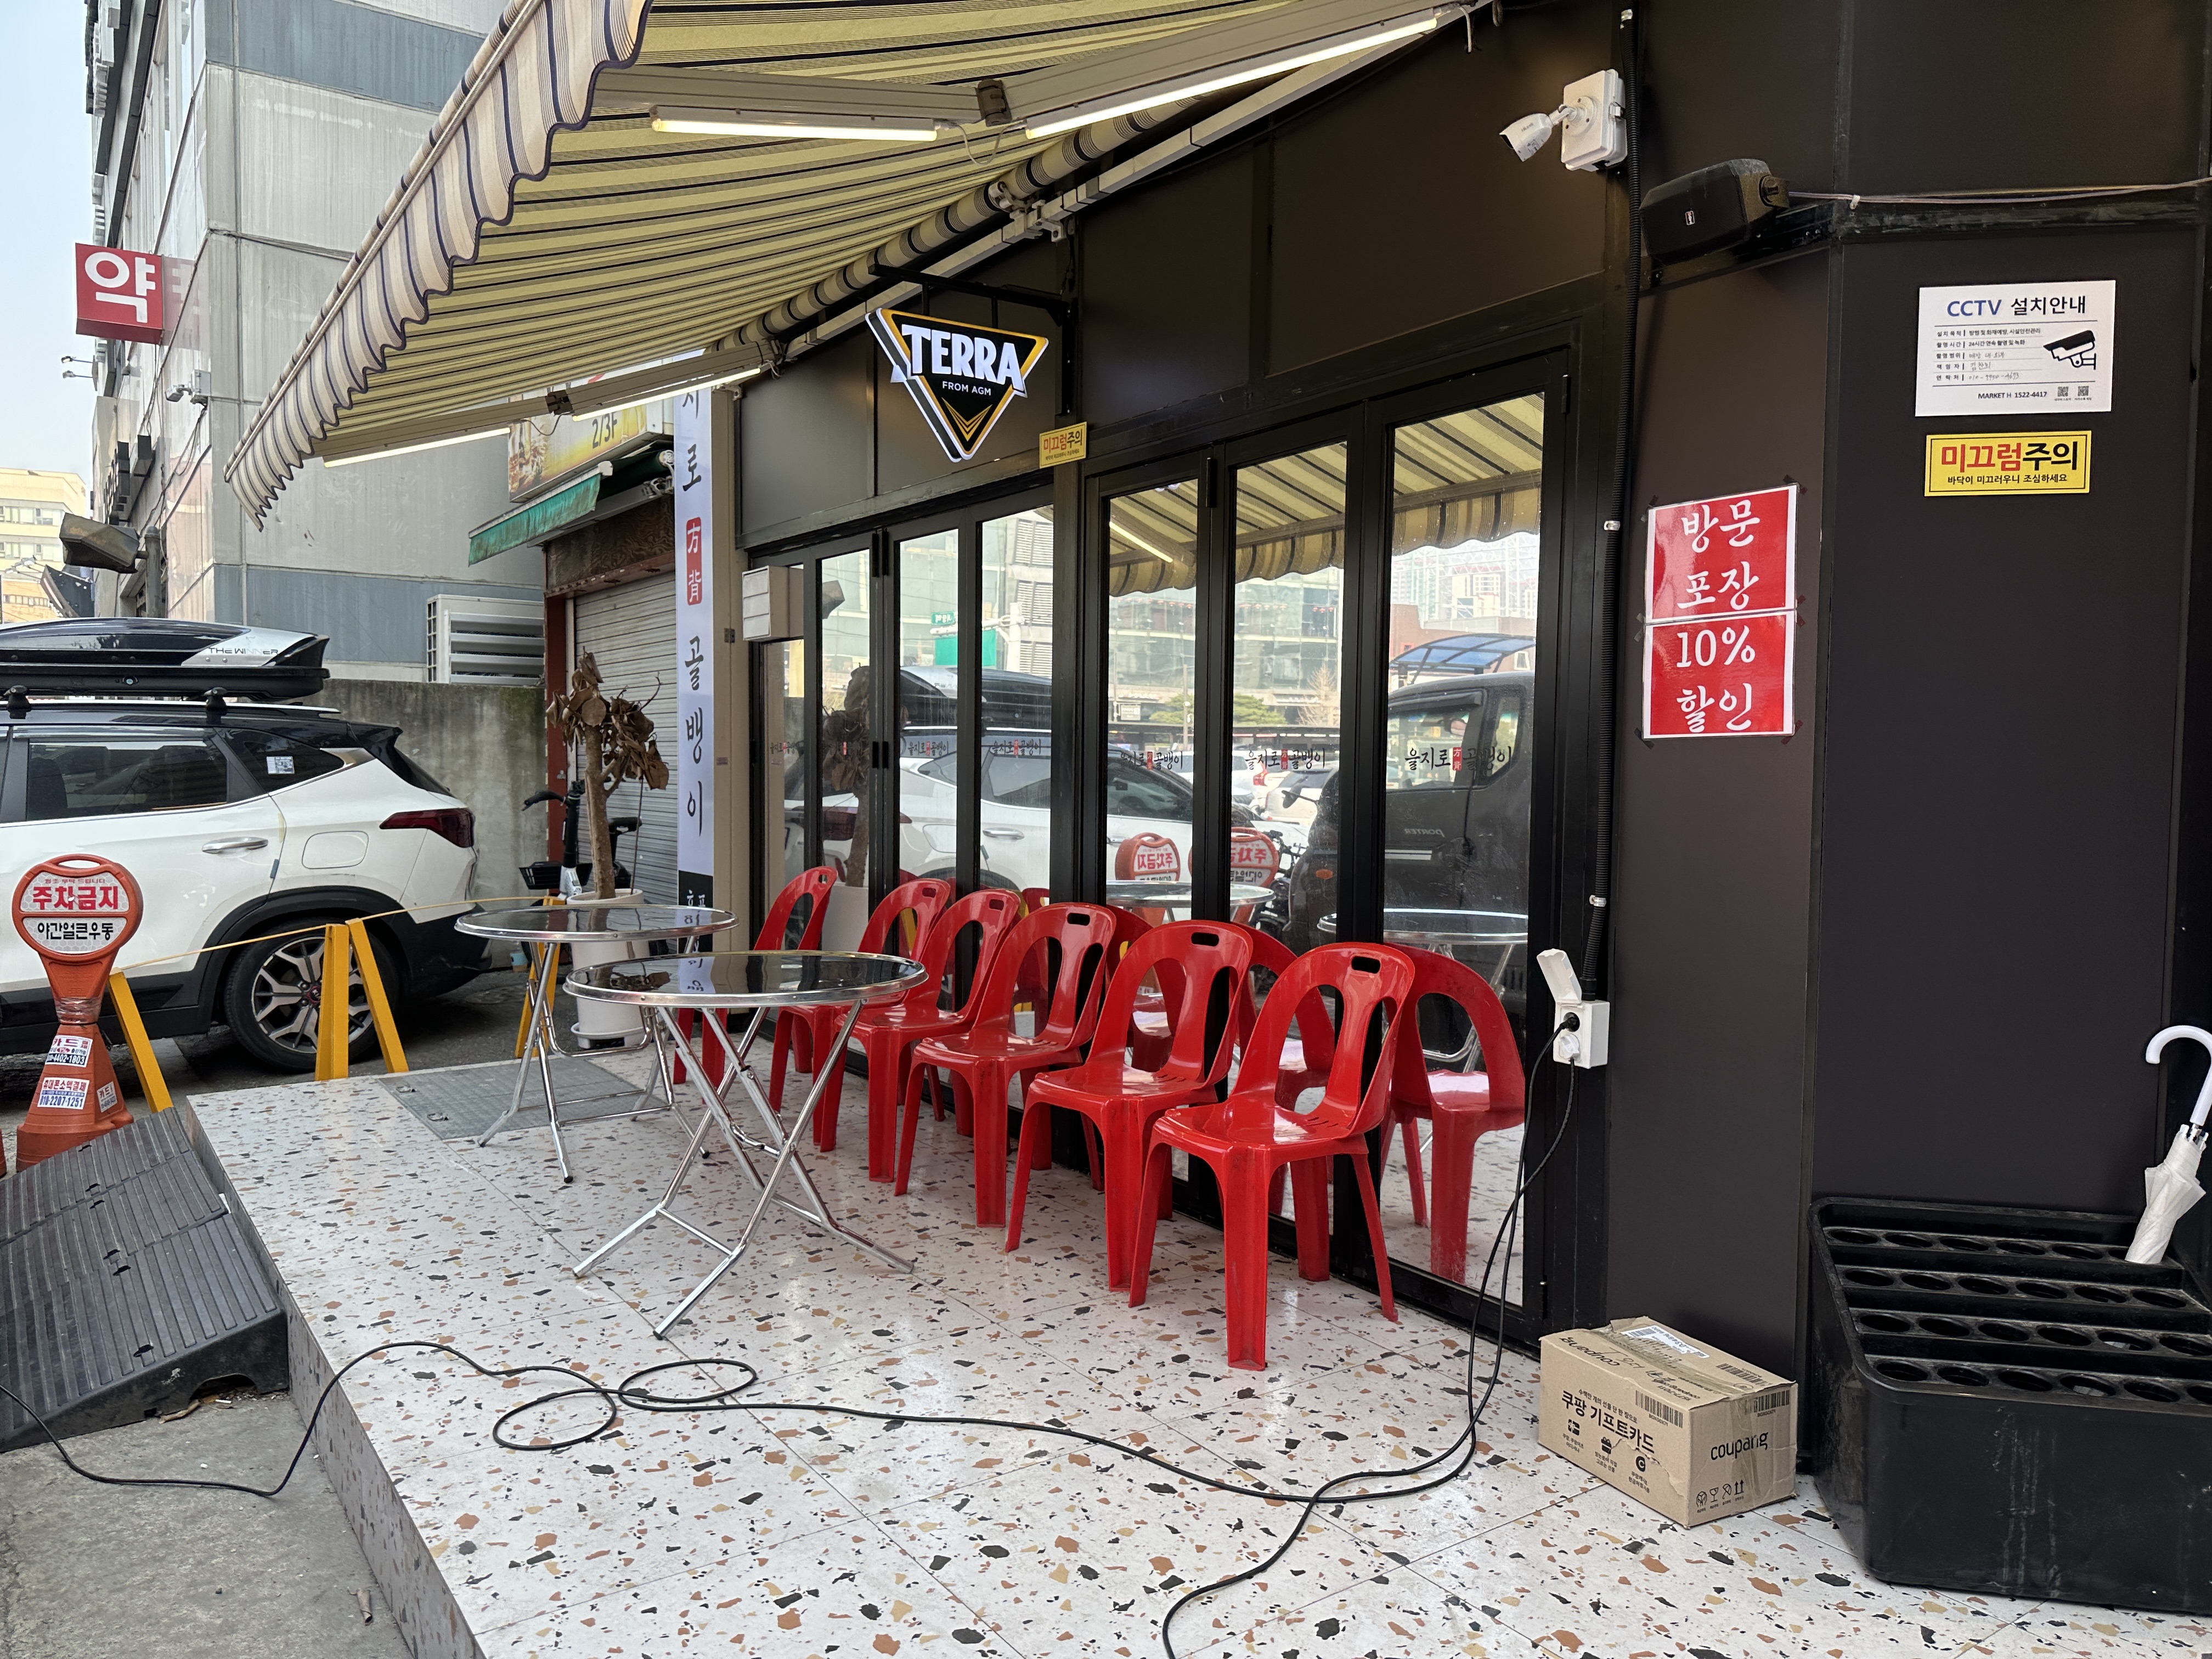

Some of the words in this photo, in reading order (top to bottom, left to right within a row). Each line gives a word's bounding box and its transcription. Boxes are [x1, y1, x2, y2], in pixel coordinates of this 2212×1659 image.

[84, 251, 155, 323] 약
[1947, 300, 2002, 317] CCTV
[2011, 295, 2086, 316] 설치안내
[901, 324, 1025, 392] TERRA
[942, 381, 969, 393] FROM
[972, 386, 991, 396] AGM
[591, 412, 618, 449] 2/3F
[1043, 428, 1082, 454] 미끄럼주의
[1941, 441, 2078, 472] 미끄럼주의
[1948, 475, 1973, 484] 바닥이
[1977, 473, 2019, 484] 미끄러우니
[2023, 473, 2068, 483] 조심하세요
[1681, 499, 1760, 553] 방문
[1677, 561, 1759, 611] 포장
[1677, 625, 1756, 668] 10%
[1677, 682, 1752, 733] 할인
[685, 635, 704, 837] 골뱅이
[1154, 751, 1183, 770] 골뱅이
[1245, 749, 1280, 770] 을지로
[1288, 747, 1325, 770] 골뱅이
[1404, 747, 1451, 770] 을지로
[32, 886, 119, 910] 주차금지
[37, 922, 114, 940] 야간얼큰우동
[43, 1079, 87, 1092] 휴대폰소액결제
[40, 1095, 83, 1108] 010-2207-1251
[1559, 1336, 1621, 1366] coupang
[1578, 1389, 1592, 1400] 수백만
[1593, 1395, 1602, 1405] 개의
[1602, 1400, 1611, 1410] 선물
[1624, 1412, 1638, 1424] 장으로
[1562, 1390, 1587, 1417] 쿠팡
[1590, 1406, 1655, 1454] 기프트카드
[1711, 1432, 1769, 1460] coupang
